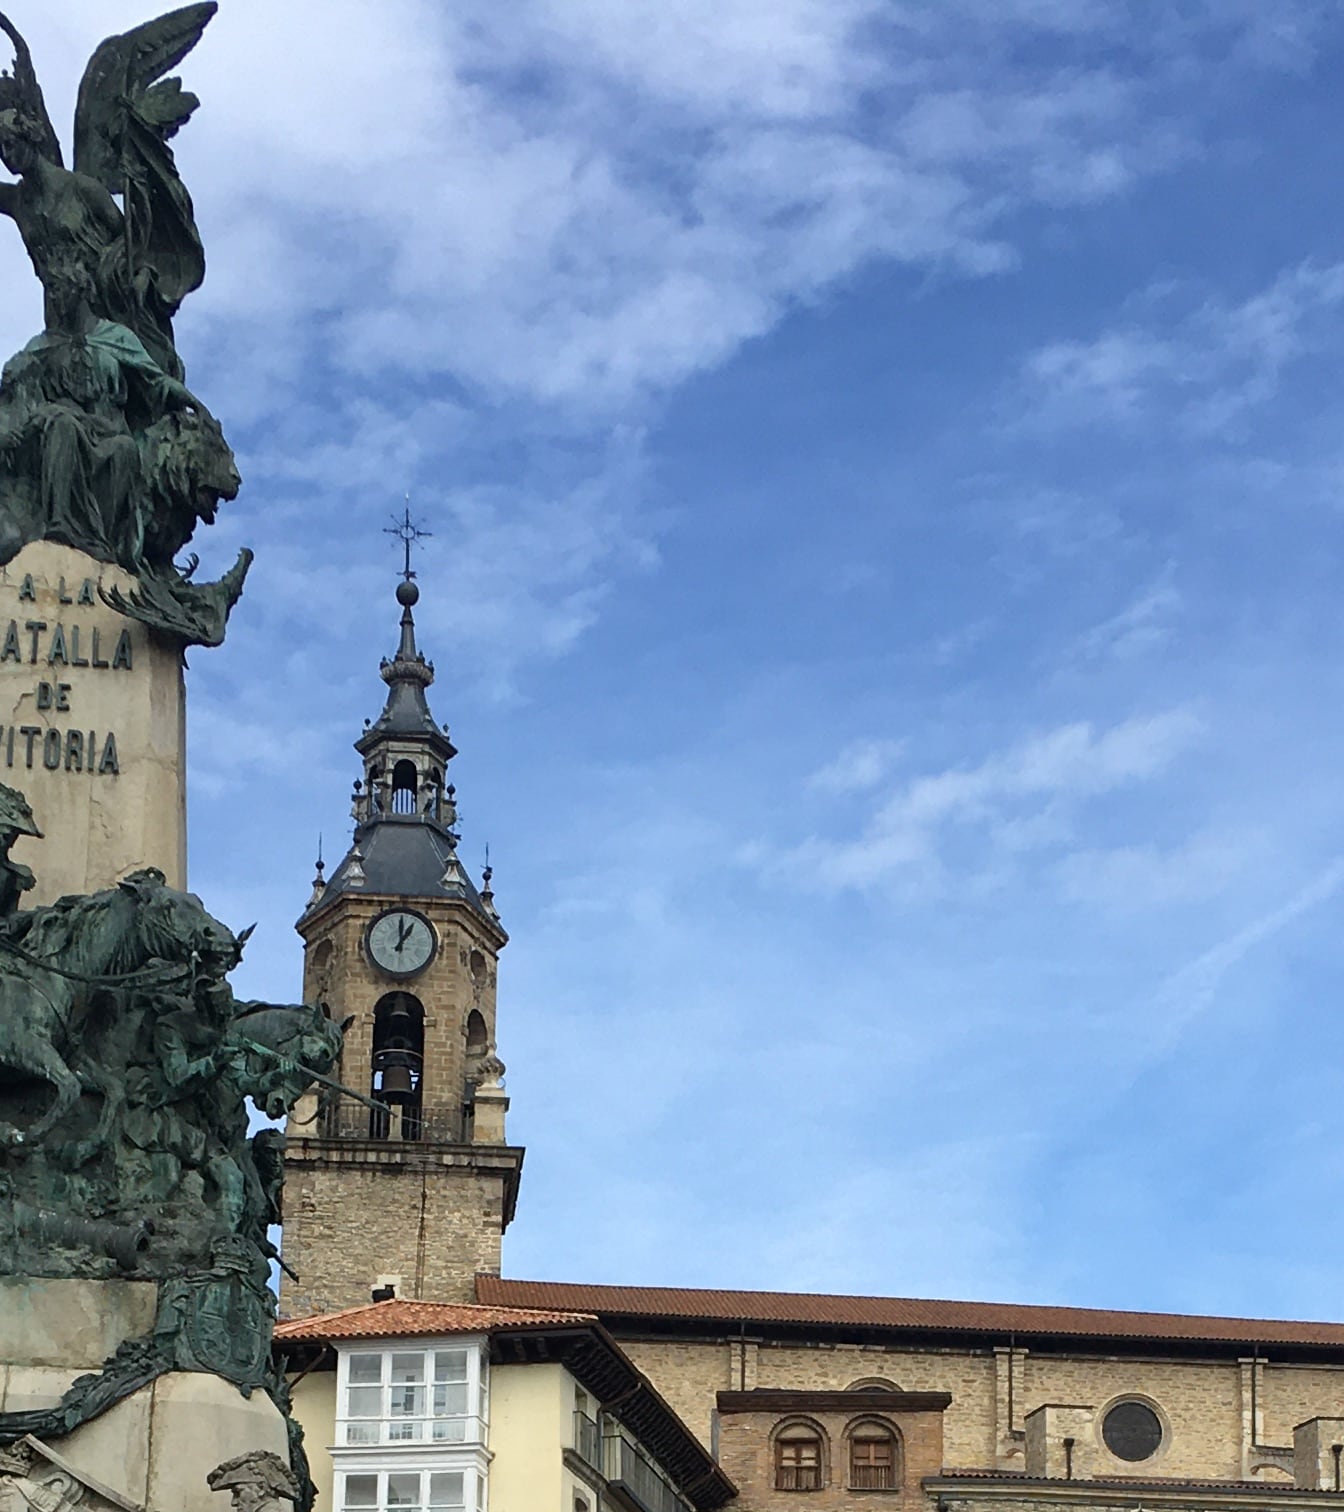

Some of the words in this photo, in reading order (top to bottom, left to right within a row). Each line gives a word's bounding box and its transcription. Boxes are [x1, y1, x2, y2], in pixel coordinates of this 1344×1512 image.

[18, 573, 37, 603] A
[59, 576, 96, 607] LA
[35, 681, 73, 713] DE
